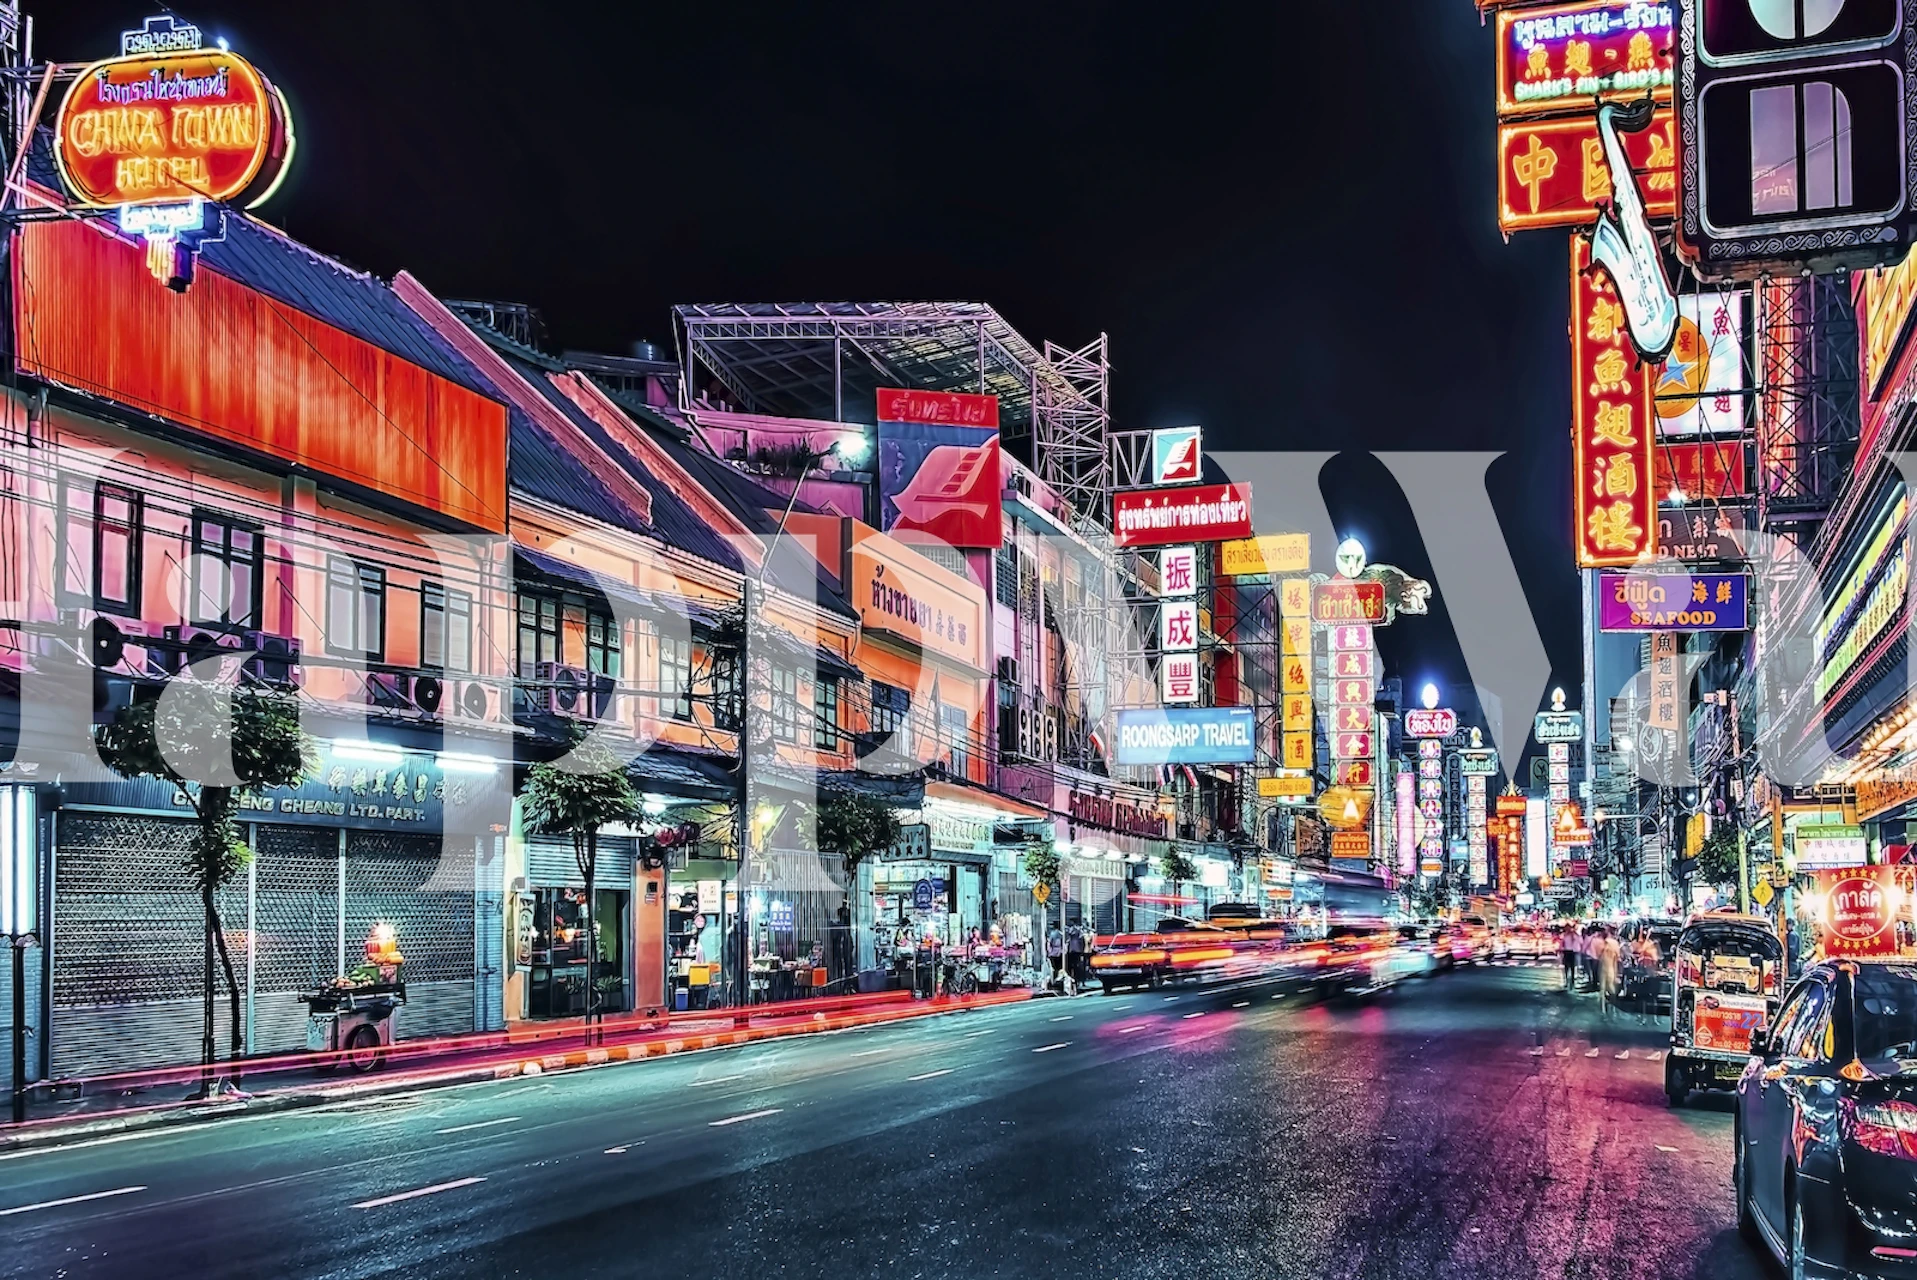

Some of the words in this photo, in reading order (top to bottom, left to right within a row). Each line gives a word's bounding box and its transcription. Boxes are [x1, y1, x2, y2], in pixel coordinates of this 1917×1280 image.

[1515, 77, 1573, 100] SHARK'S
[70, 107, 164, 155] CHINA
[171, 103, 257, 150] TOWN
[1588, 272, 1643, 551] 都魚翅酒樓
[1674, 544, 1718, 558] NEST
[1692, 580, 1732, 605] 海鮮
[1166, 555, 1193, 697] 振成豐
[1630, 611, 1716, 625] SEAFOOD
[1122, 723, 1200, 748] ROONGSARP
[1203, 722, 1250, 747] TRAVEL
[281, 797, 344, 817] CHEANG
[1742, 1011, 1763, 1029] 22
